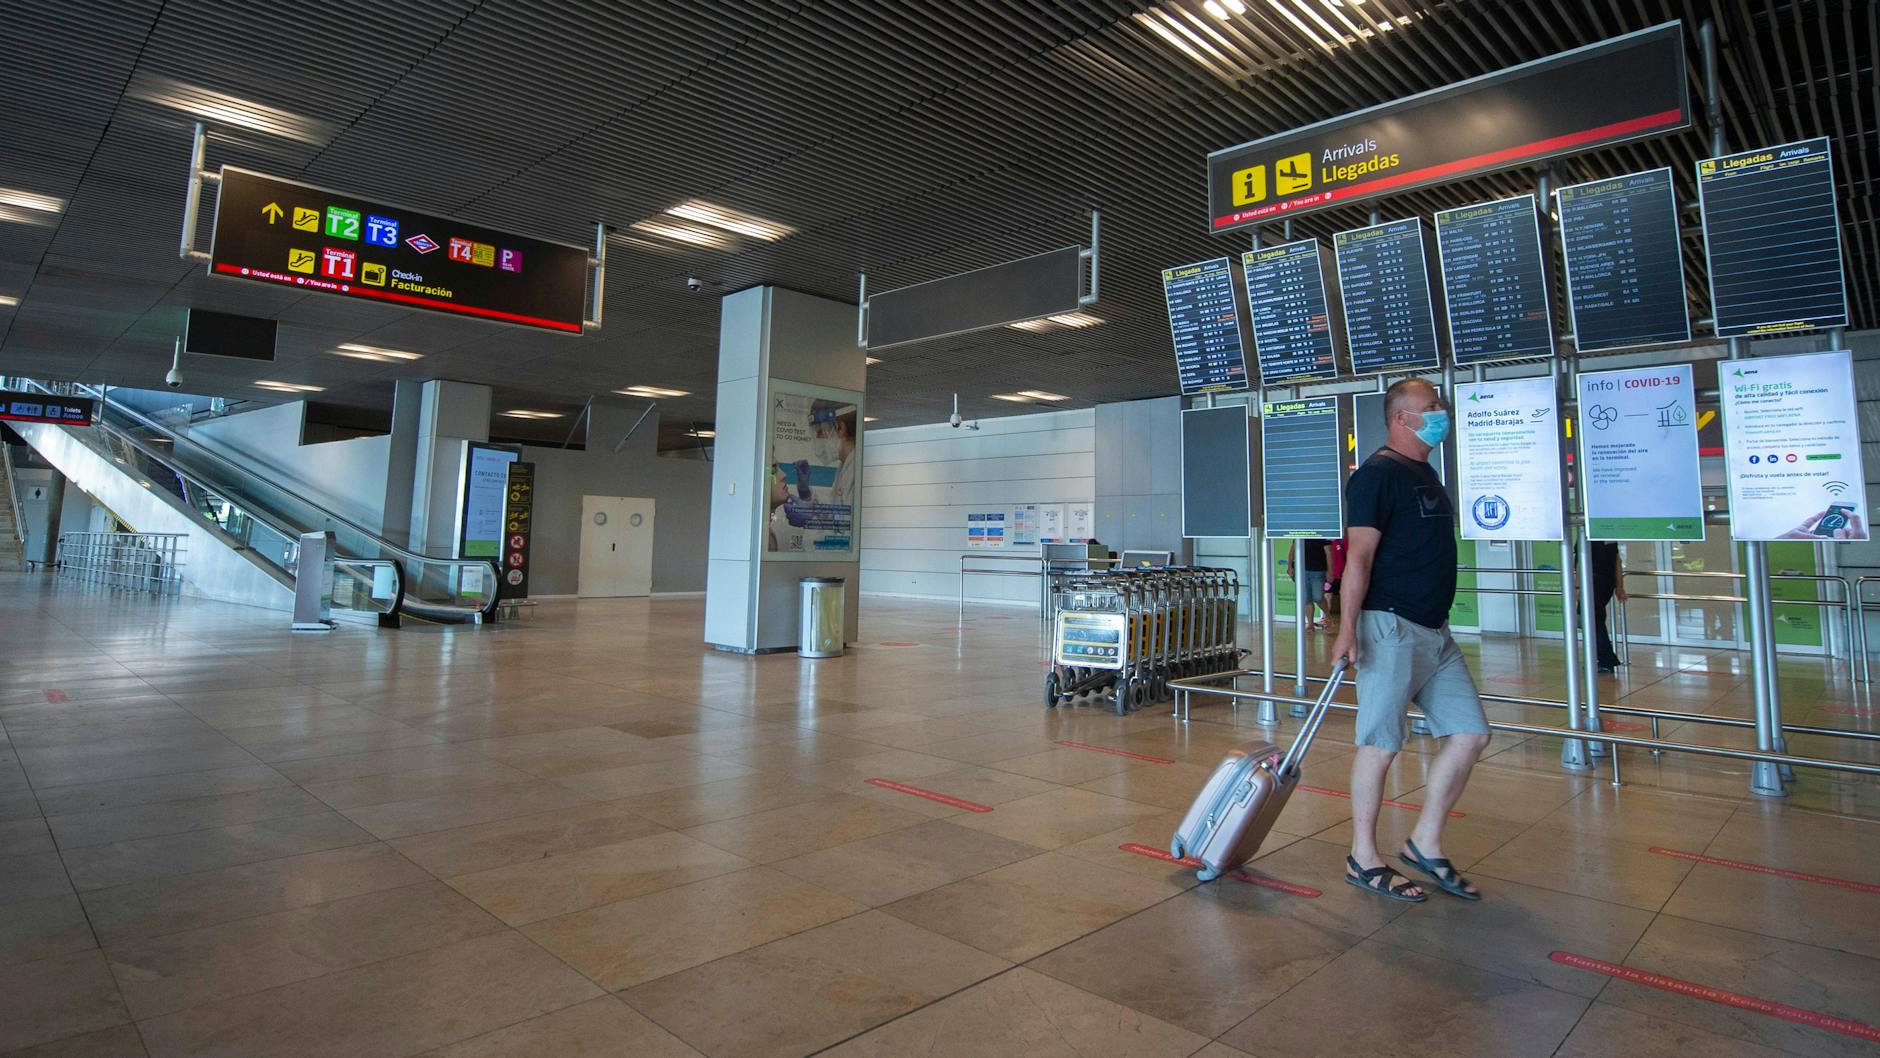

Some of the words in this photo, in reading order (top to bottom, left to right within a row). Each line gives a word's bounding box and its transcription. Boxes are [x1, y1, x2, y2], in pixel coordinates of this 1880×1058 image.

[1322, 138, 1376, 163] Arrivals
[1722, 153, 1773, 169] Llegadas
[1780, 146, 1809, 158] Arrivals
[1322, 153, 1400, 184] Llegadas
[1580, 182, 1623, 196] Llegadas
[330, 208, 358, 218] Terminal
[370, 217, 397, 227] Terminal
[1455, 207, 1493, 219] Llegadas
[328, 214, 359, 238] T2
[368, 223, 397, 245] T3
[451, 243, 471, 260] T4
[503, 249, 513, 262] P
[1351, 230, 1384, 240] Llegadas
[326, 248, 354, 259] Terminal
[1257, 250, 1286, 260] Llegadas
[324, 254, 354, 278] T1
[1175, 267, 1201, 276] Llegadas
[392, 269, 422, 282] Check-in
[391, 279, 453, 297] Facturación
[1588, 380, 1613, 391] info
[1625, 376, 1680, 388] COVID-19
[1734, 384, 1759, 392] Wi-Fi
[1762, 382, 1792, 392] gratis
[1468, 418, 1524, 427] Madrid-Barajas
[1644, 976, 1717, 997] distancia
